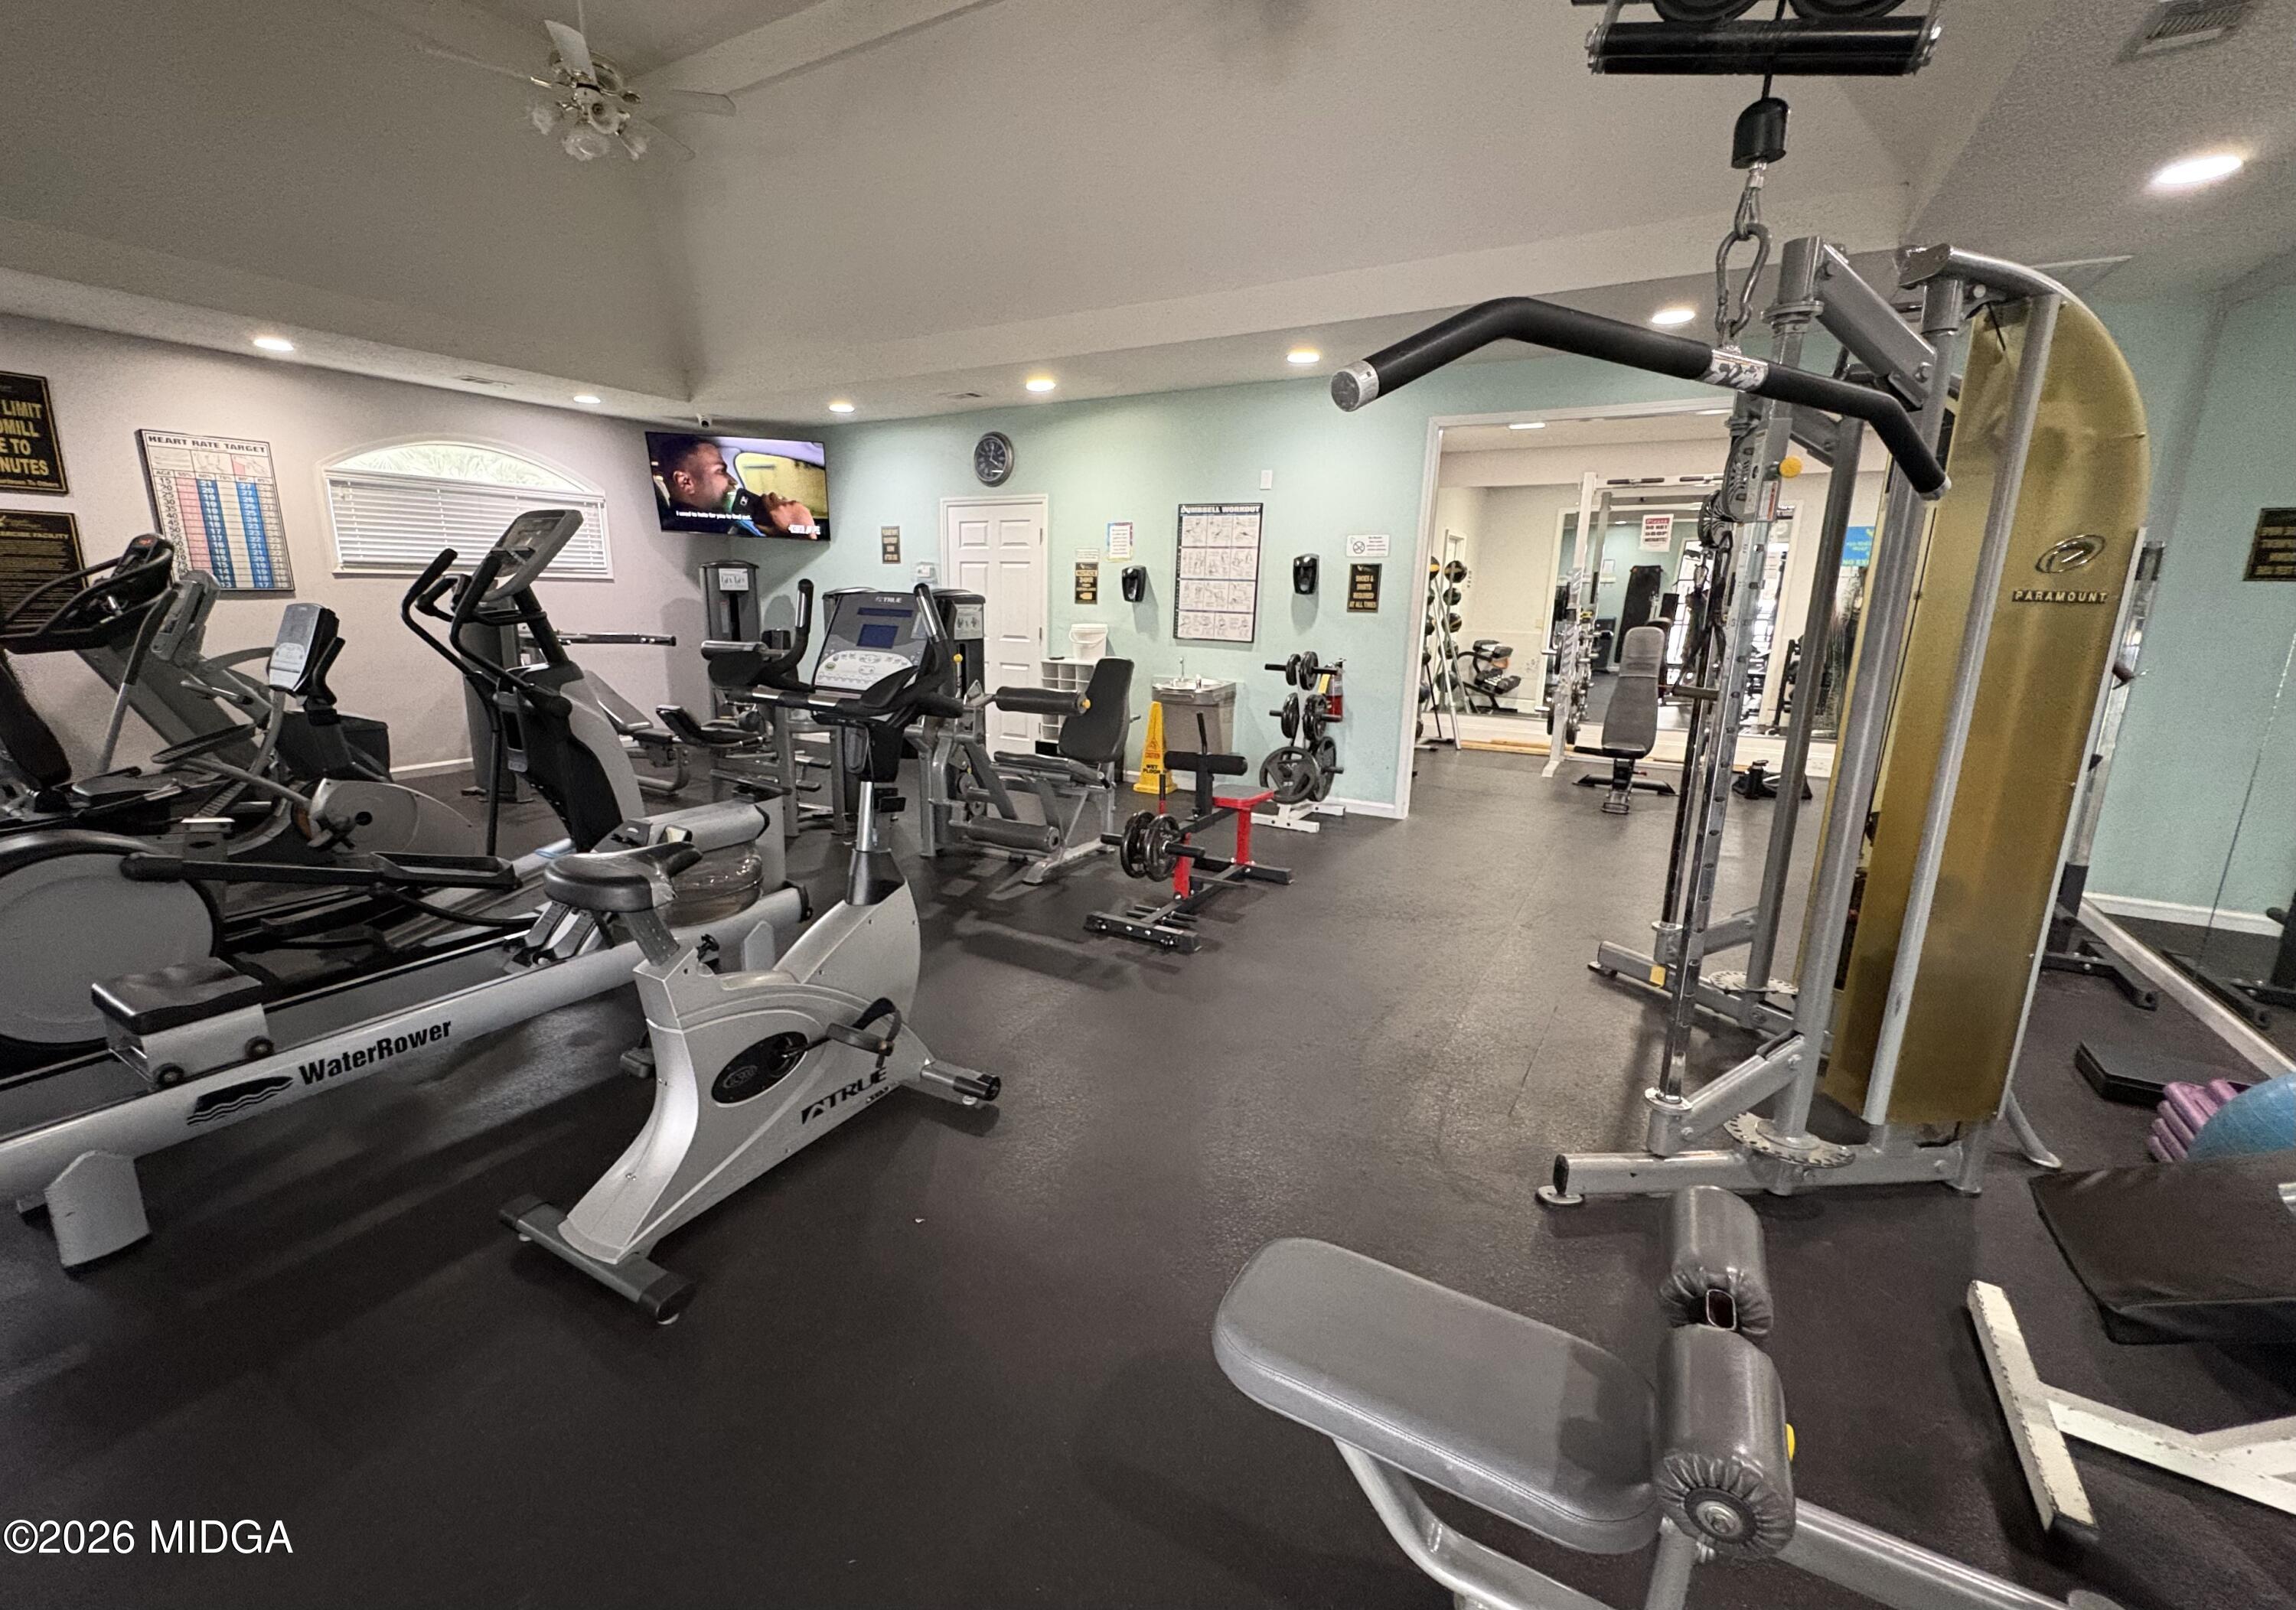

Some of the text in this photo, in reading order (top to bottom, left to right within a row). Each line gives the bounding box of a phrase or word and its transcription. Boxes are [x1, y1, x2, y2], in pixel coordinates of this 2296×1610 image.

[2, 399, 41, 419] LIMIT
[10, 438, 31, 455] TO
[148, 435, 266, 453] HEART RATE TARGET
[2014, 591, 2108, 602] PARAMOUNT
[298, 1021, 452, 1085] WaterRower
[820, 1067, 887, 1109] TRUE
